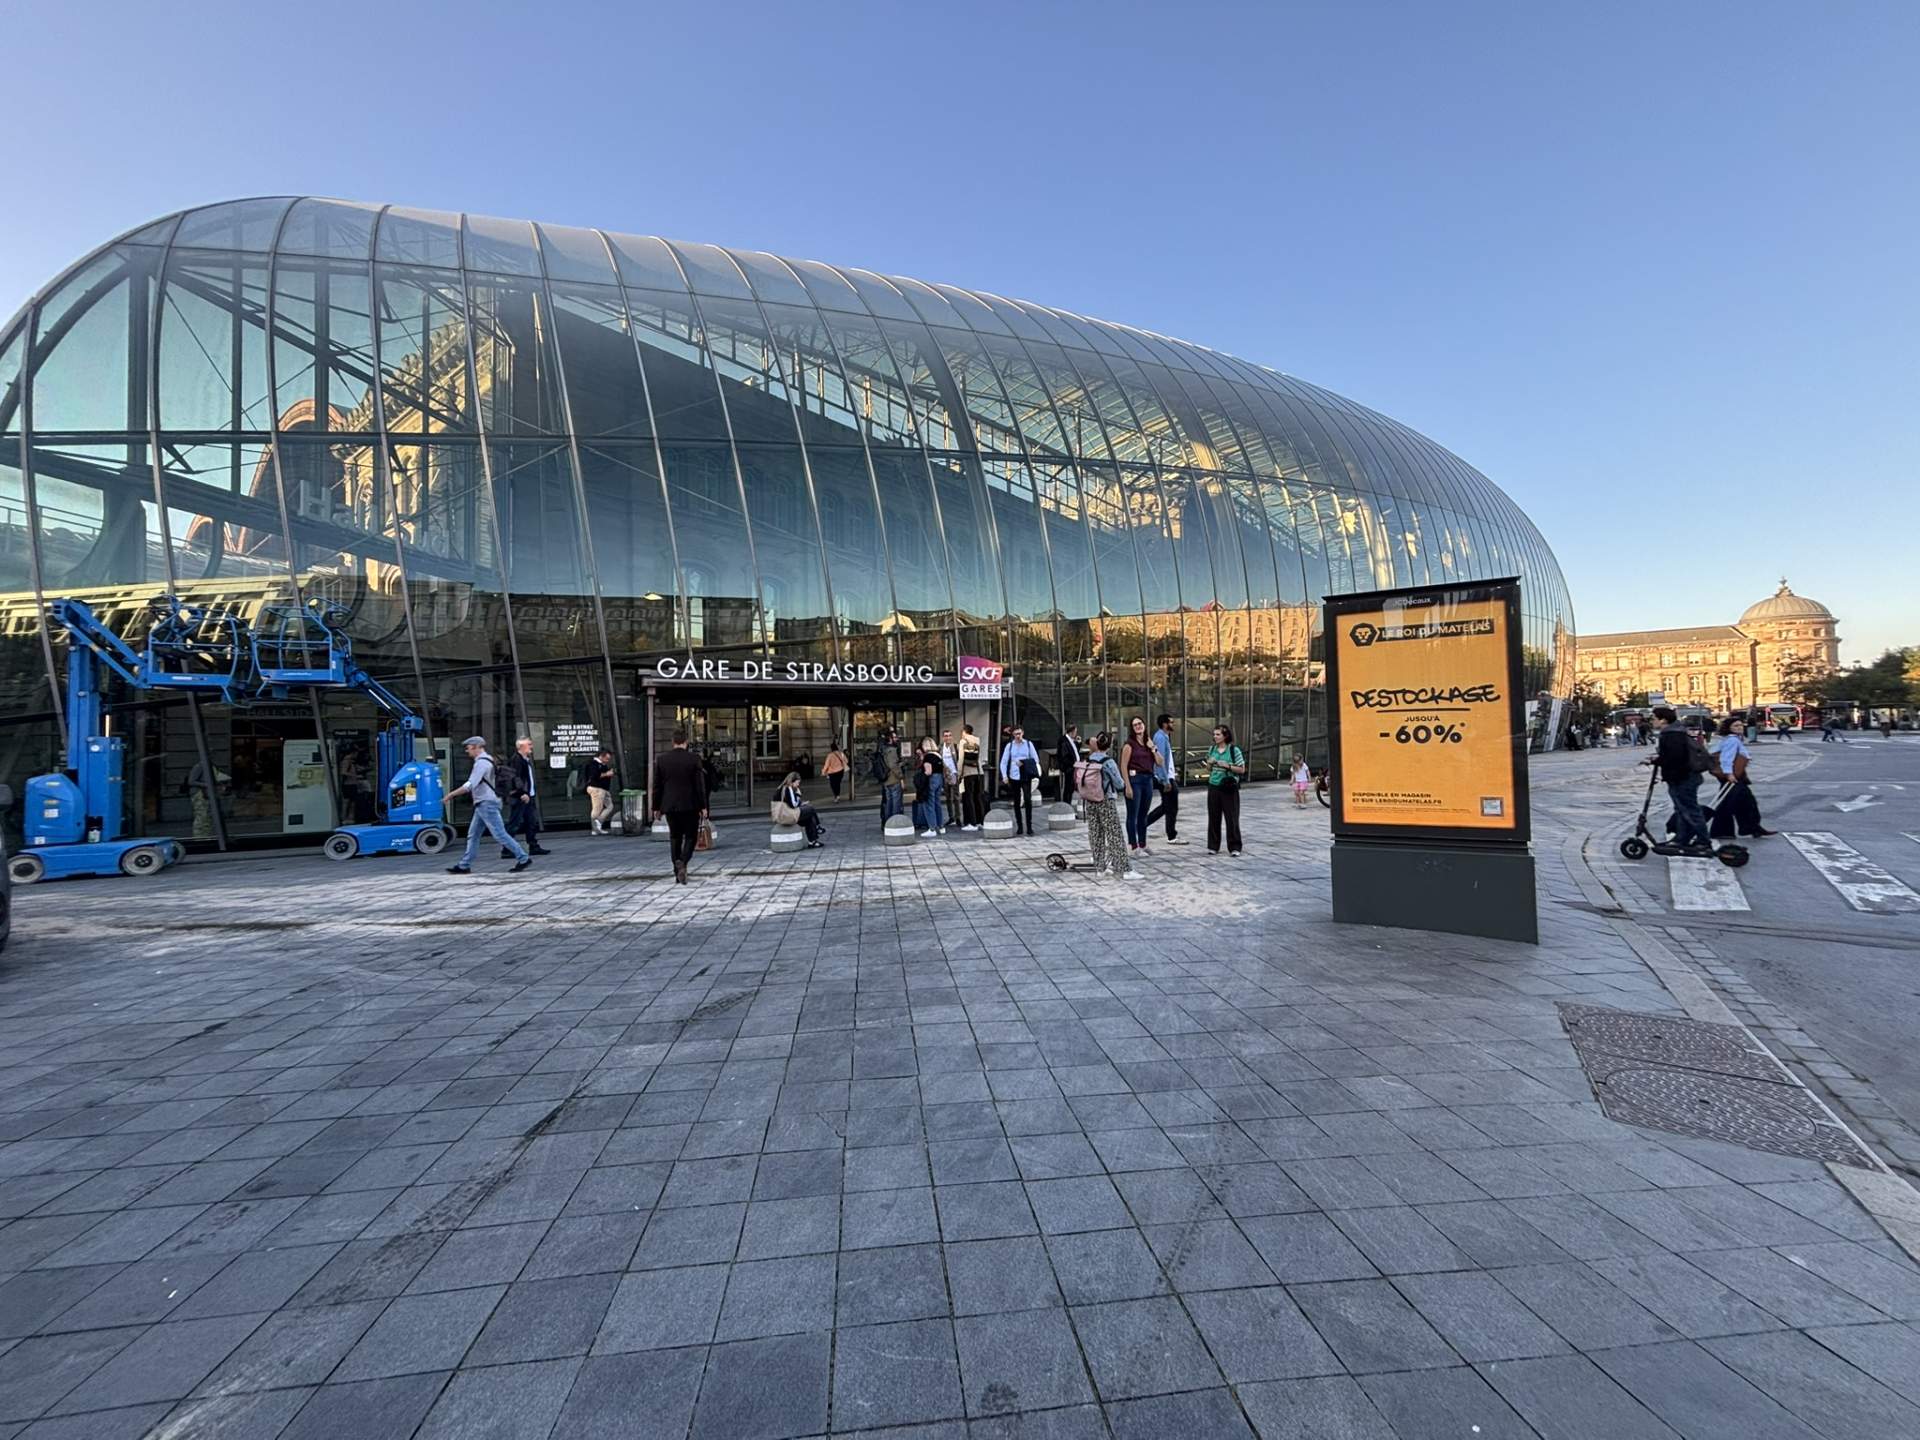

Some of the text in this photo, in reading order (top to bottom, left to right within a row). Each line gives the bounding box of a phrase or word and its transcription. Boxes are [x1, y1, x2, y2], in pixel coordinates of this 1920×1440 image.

[1438, 621, 1491, 635] MATELAS
[656, 658, 934, 683] GARE DE STRASBOURG
[962, 666, 1000, 680] SNCF
[961, 685, 1000, 693] GARES
[1350, 684, 1501, 709] DESTOCKAGE
